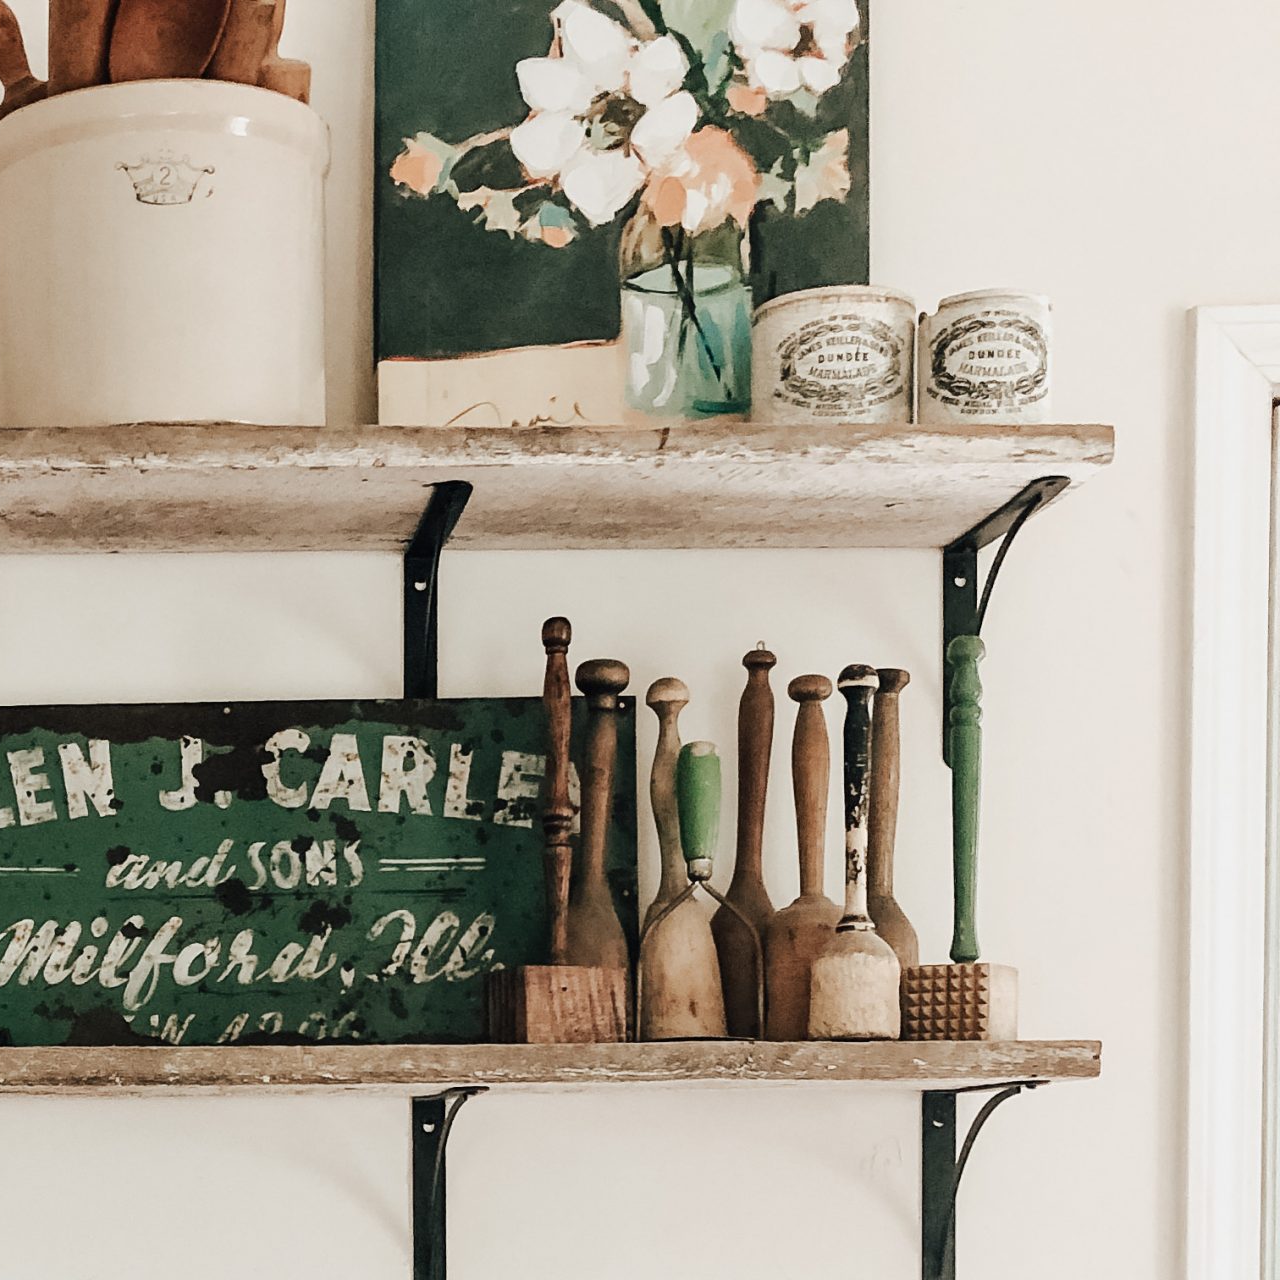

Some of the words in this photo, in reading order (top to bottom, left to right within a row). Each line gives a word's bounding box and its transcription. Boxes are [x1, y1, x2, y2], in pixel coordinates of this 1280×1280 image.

[818, 351, 869, 363] DUNDEE
[969, 350, 1021, 360] DUNDEE
[106, 838, 236, 890] and
[246, 839, 365, 890] SONS
